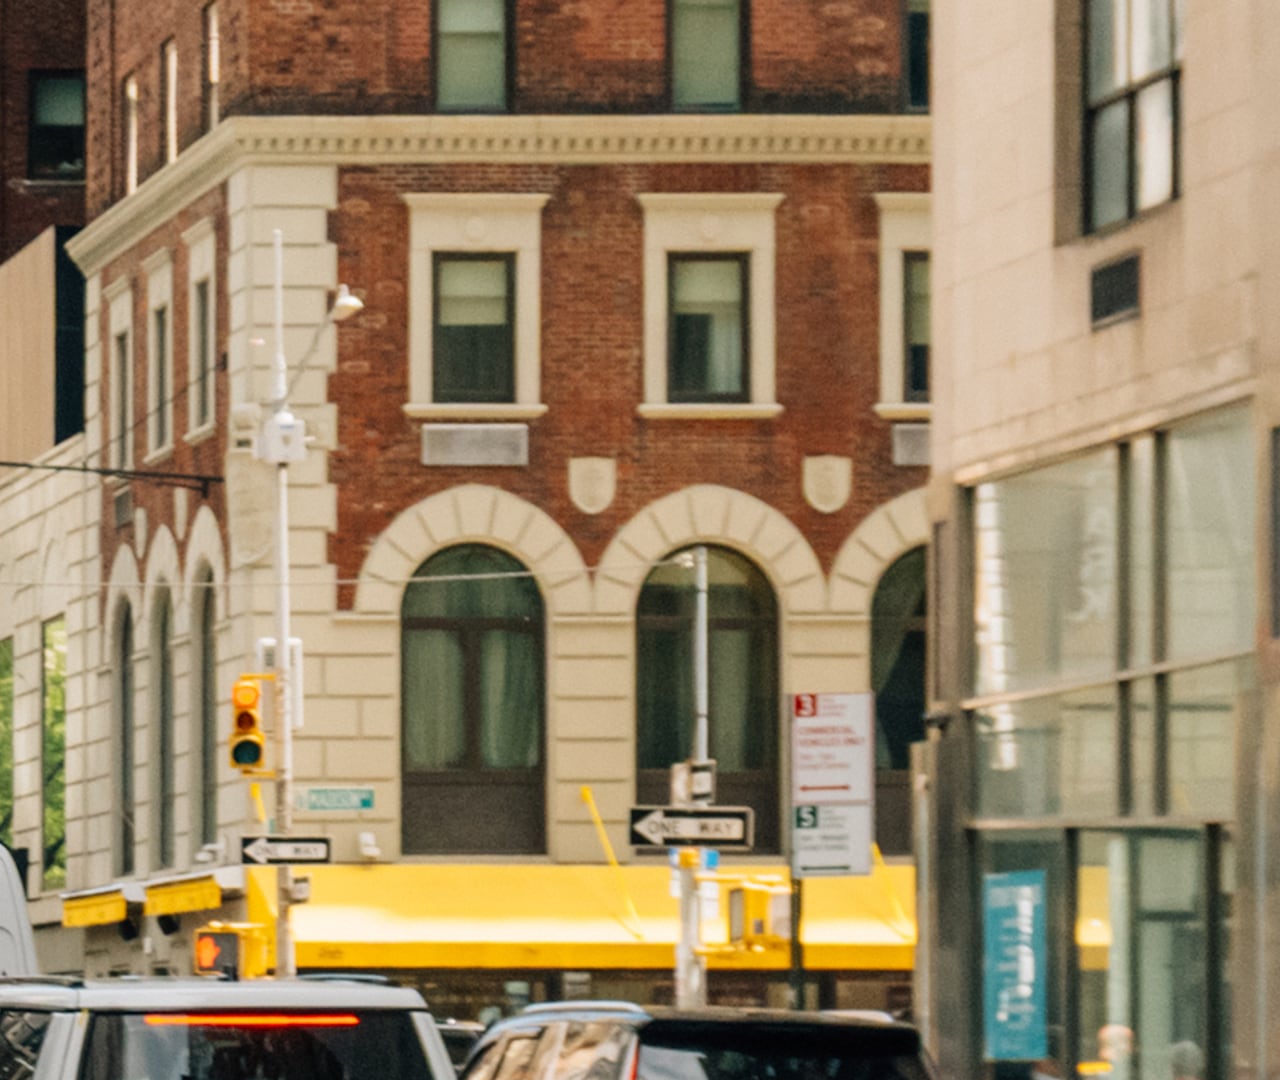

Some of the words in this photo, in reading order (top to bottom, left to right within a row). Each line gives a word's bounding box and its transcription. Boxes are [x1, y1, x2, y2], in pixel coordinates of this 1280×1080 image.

[800, 694, 814, 716] 3
[647, 821, 680, 834] ONE
[700, 822, 734, 835] WAY
[801, 807, 814, 828] 5
